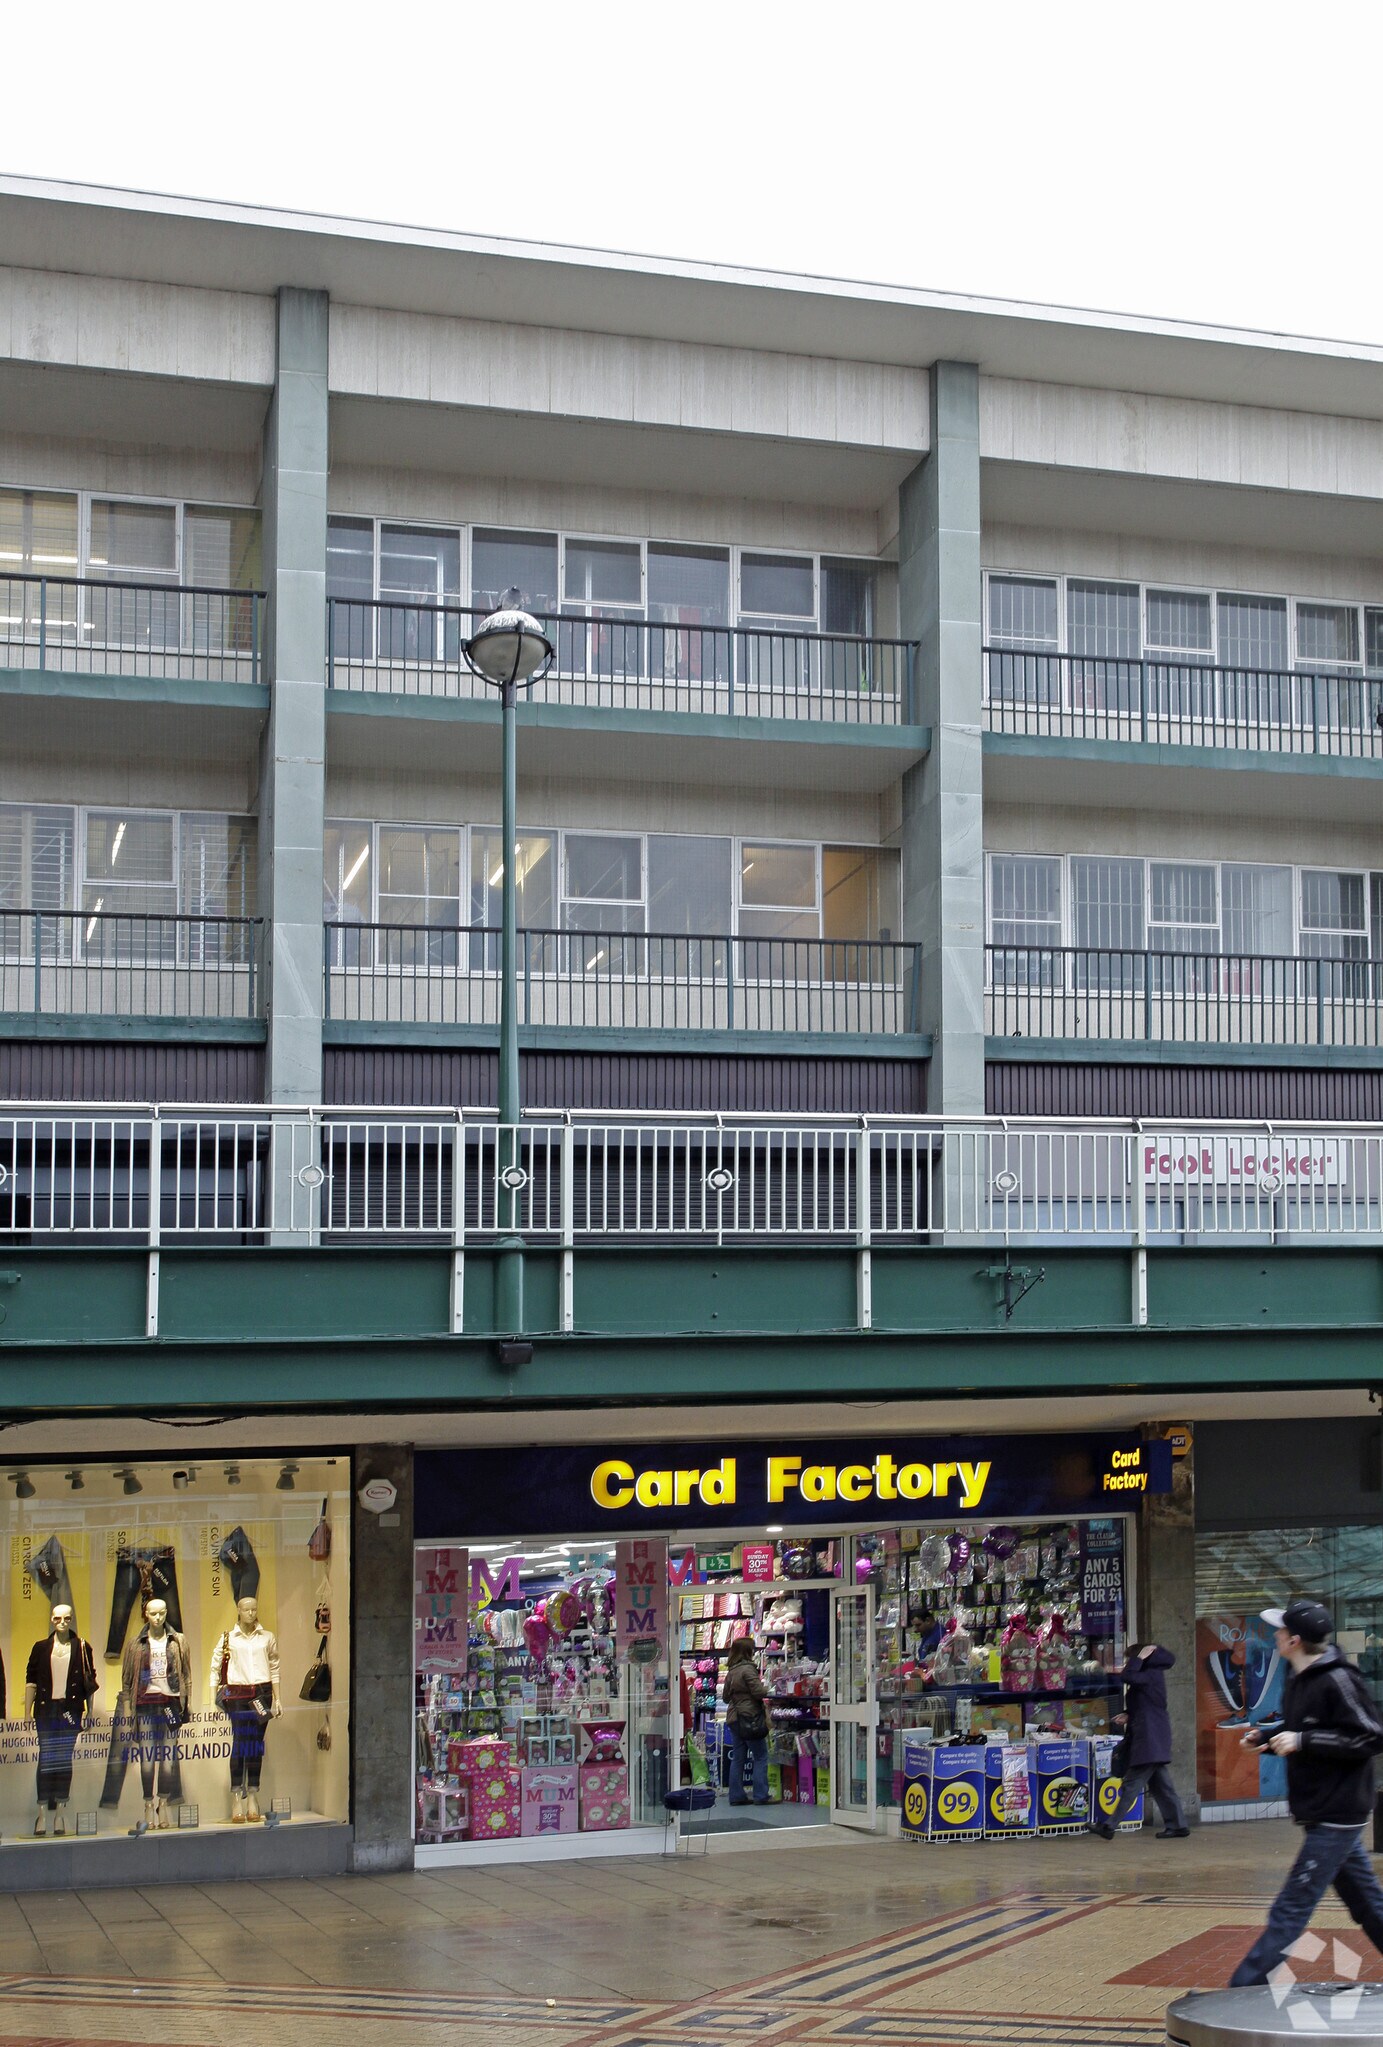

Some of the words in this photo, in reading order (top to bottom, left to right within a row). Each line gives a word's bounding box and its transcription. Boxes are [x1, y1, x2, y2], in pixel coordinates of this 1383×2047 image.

[1229, 1147, 1332, 1176] Locker
[1111, 1447, 1140, 1469] Card
[590, 1457, 736, 1509] Card
[767, 1454, 992, 1509] Factory
[1103, 1471, 1148, 1491] Factory
[211, 1527, 220, 1572] COUNTRY
[1085, 1558, 1109, 1573] ANY
[1112, 1557, 1120, 1572] 5
[22, 1576, 31, 1601] ZEST
[211, 1576, 220, 1597] SUN
[1083, 1572, 1121, 1588] CARDS
[1083, 1588, 1105, 1603] FOR
[1109, 1587, 1122, 1602] £1
[525, 1787, 576, 1803] MUM
